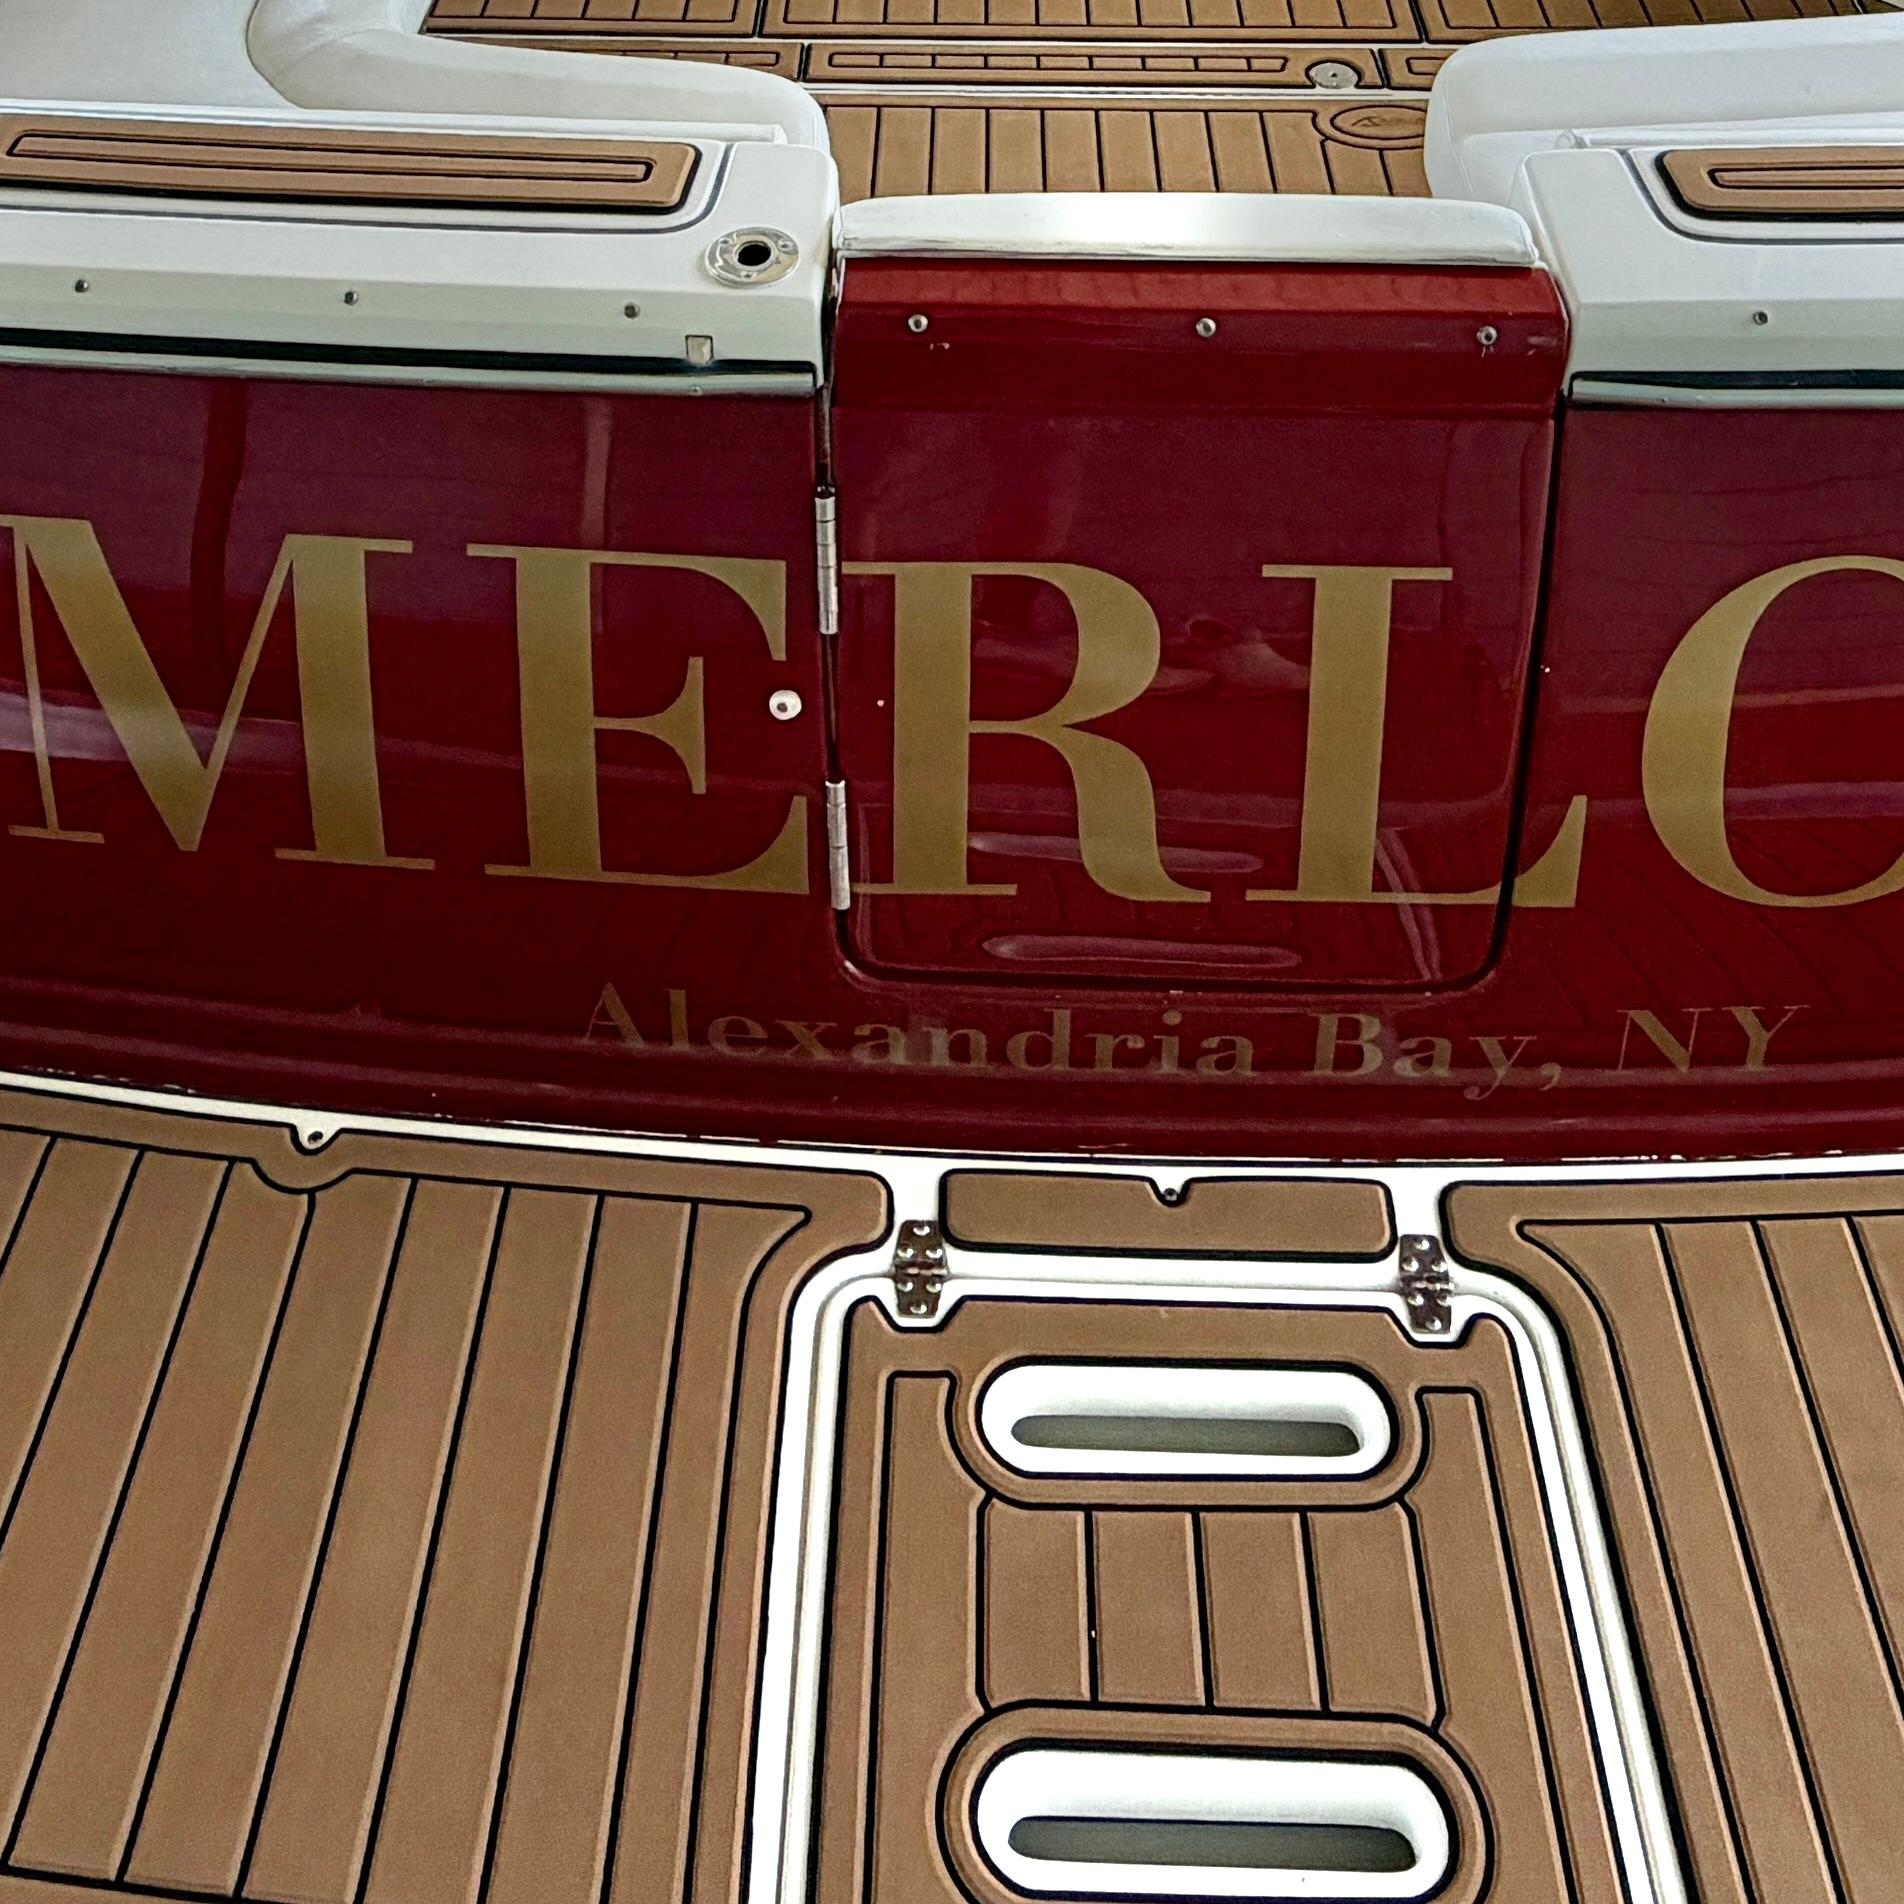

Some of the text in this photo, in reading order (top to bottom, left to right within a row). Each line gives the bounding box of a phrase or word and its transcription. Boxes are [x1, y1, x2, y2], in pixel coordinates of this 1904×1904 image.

[581, 981, 1812, 1100] Alexandria Bay, NY
